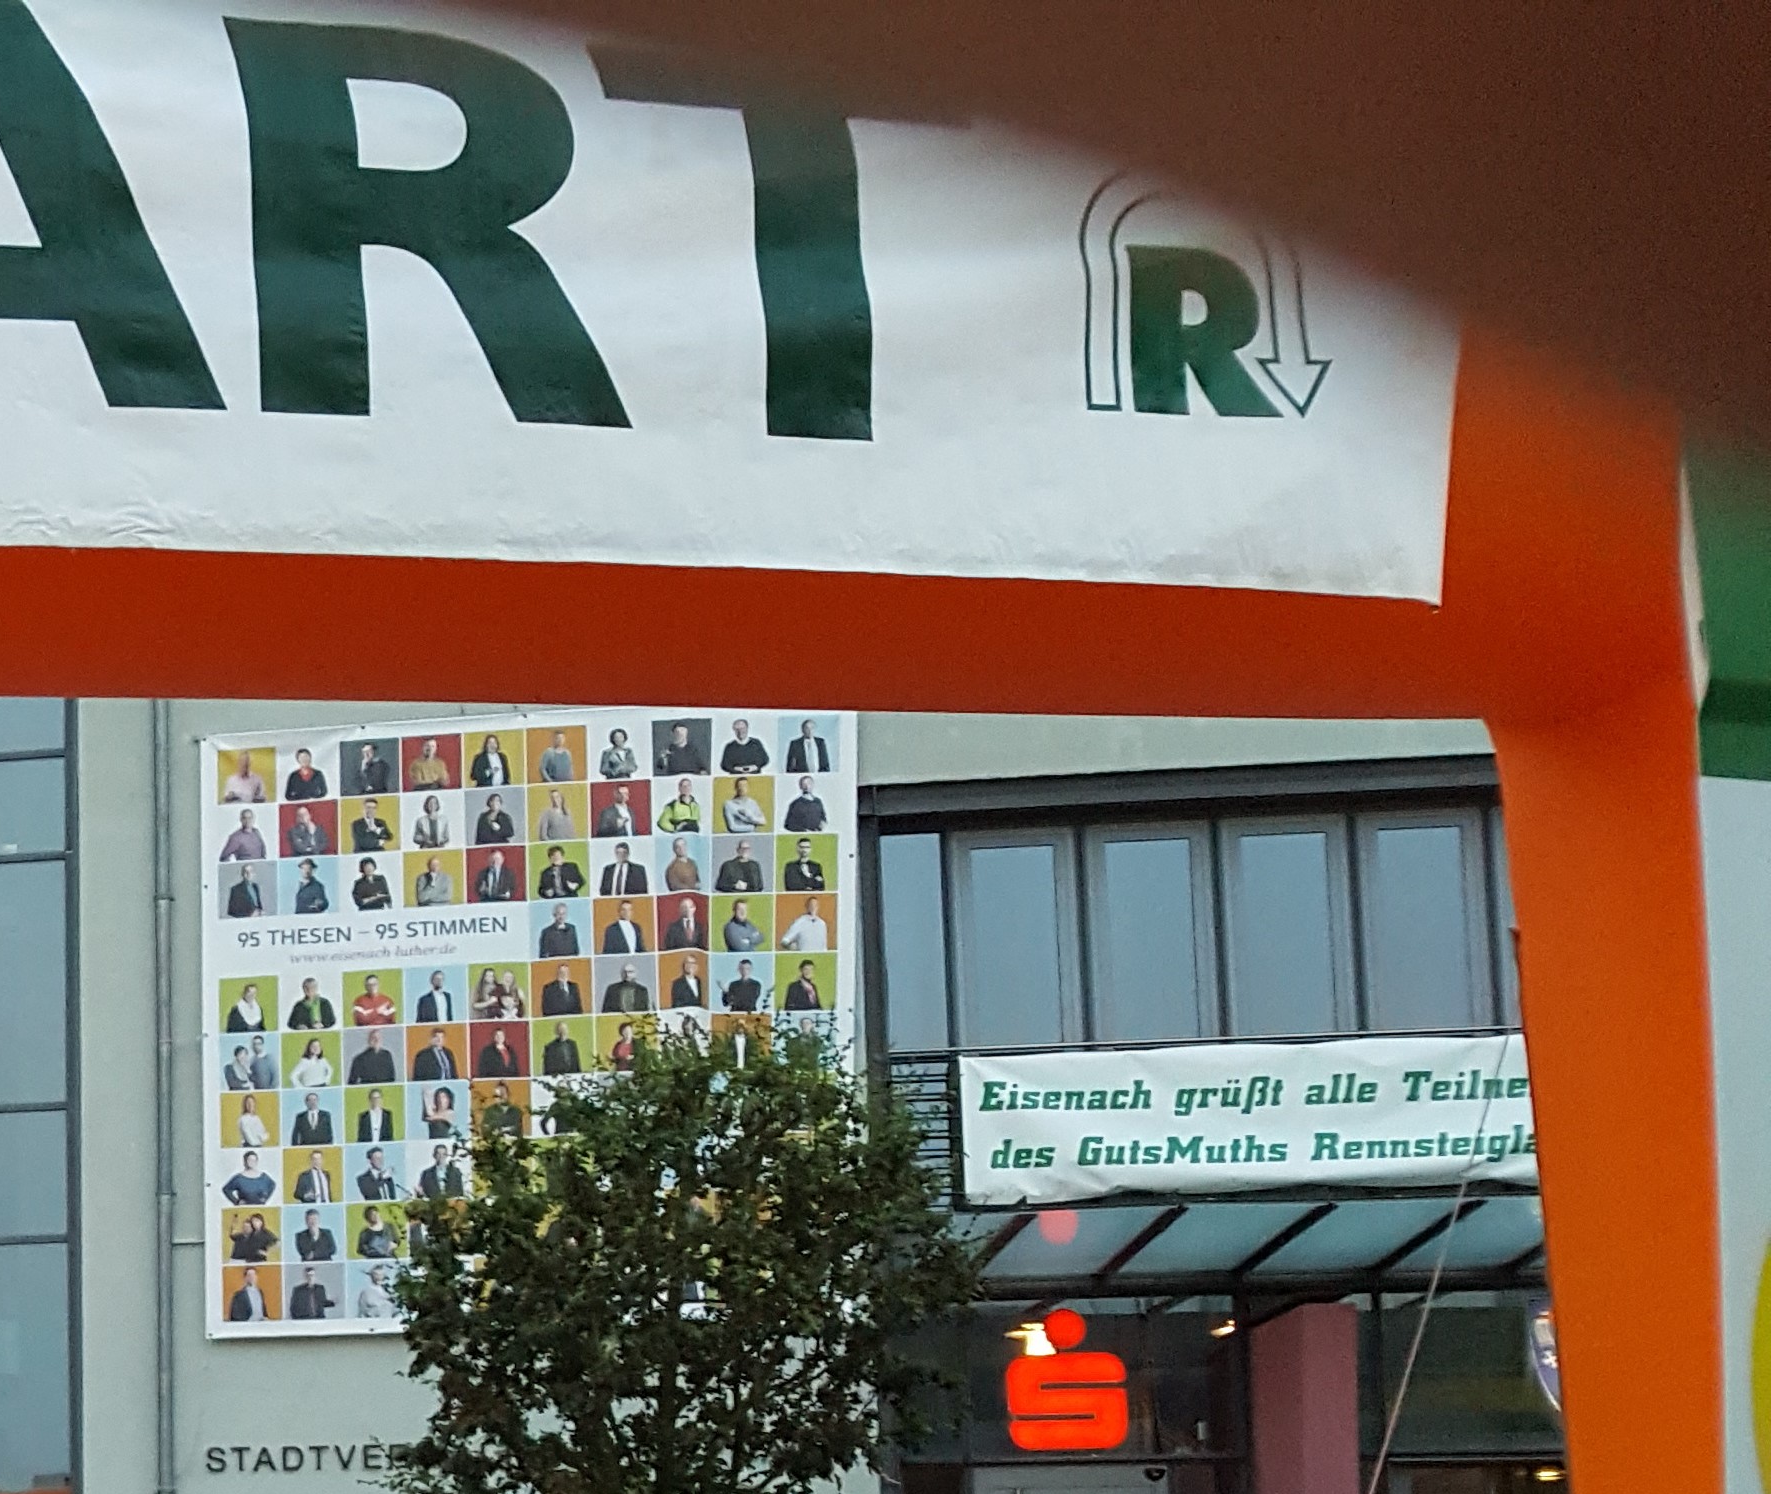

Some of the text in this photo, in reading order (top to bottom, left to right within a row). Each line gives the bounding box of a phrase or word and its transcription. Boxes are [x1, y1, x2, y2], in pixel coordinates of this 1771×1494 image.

[1125, 244, 1284, 418] R
[237, 931, 260, 948] 95
[267, 926, 352, 946] THESEN
[375, 922, 399, 940] 95
[406, 916, 508, 938] STIMMEN
[979, 1079, 1152, 1112] Eisenach
[1174, 1075, 1284, 1117] grüßt
[1305, 1072, 1378, 1105] alle
[990, 1138, 1056, 1169] des
[1077, 1135, 1289, 1166] GutsMuths
